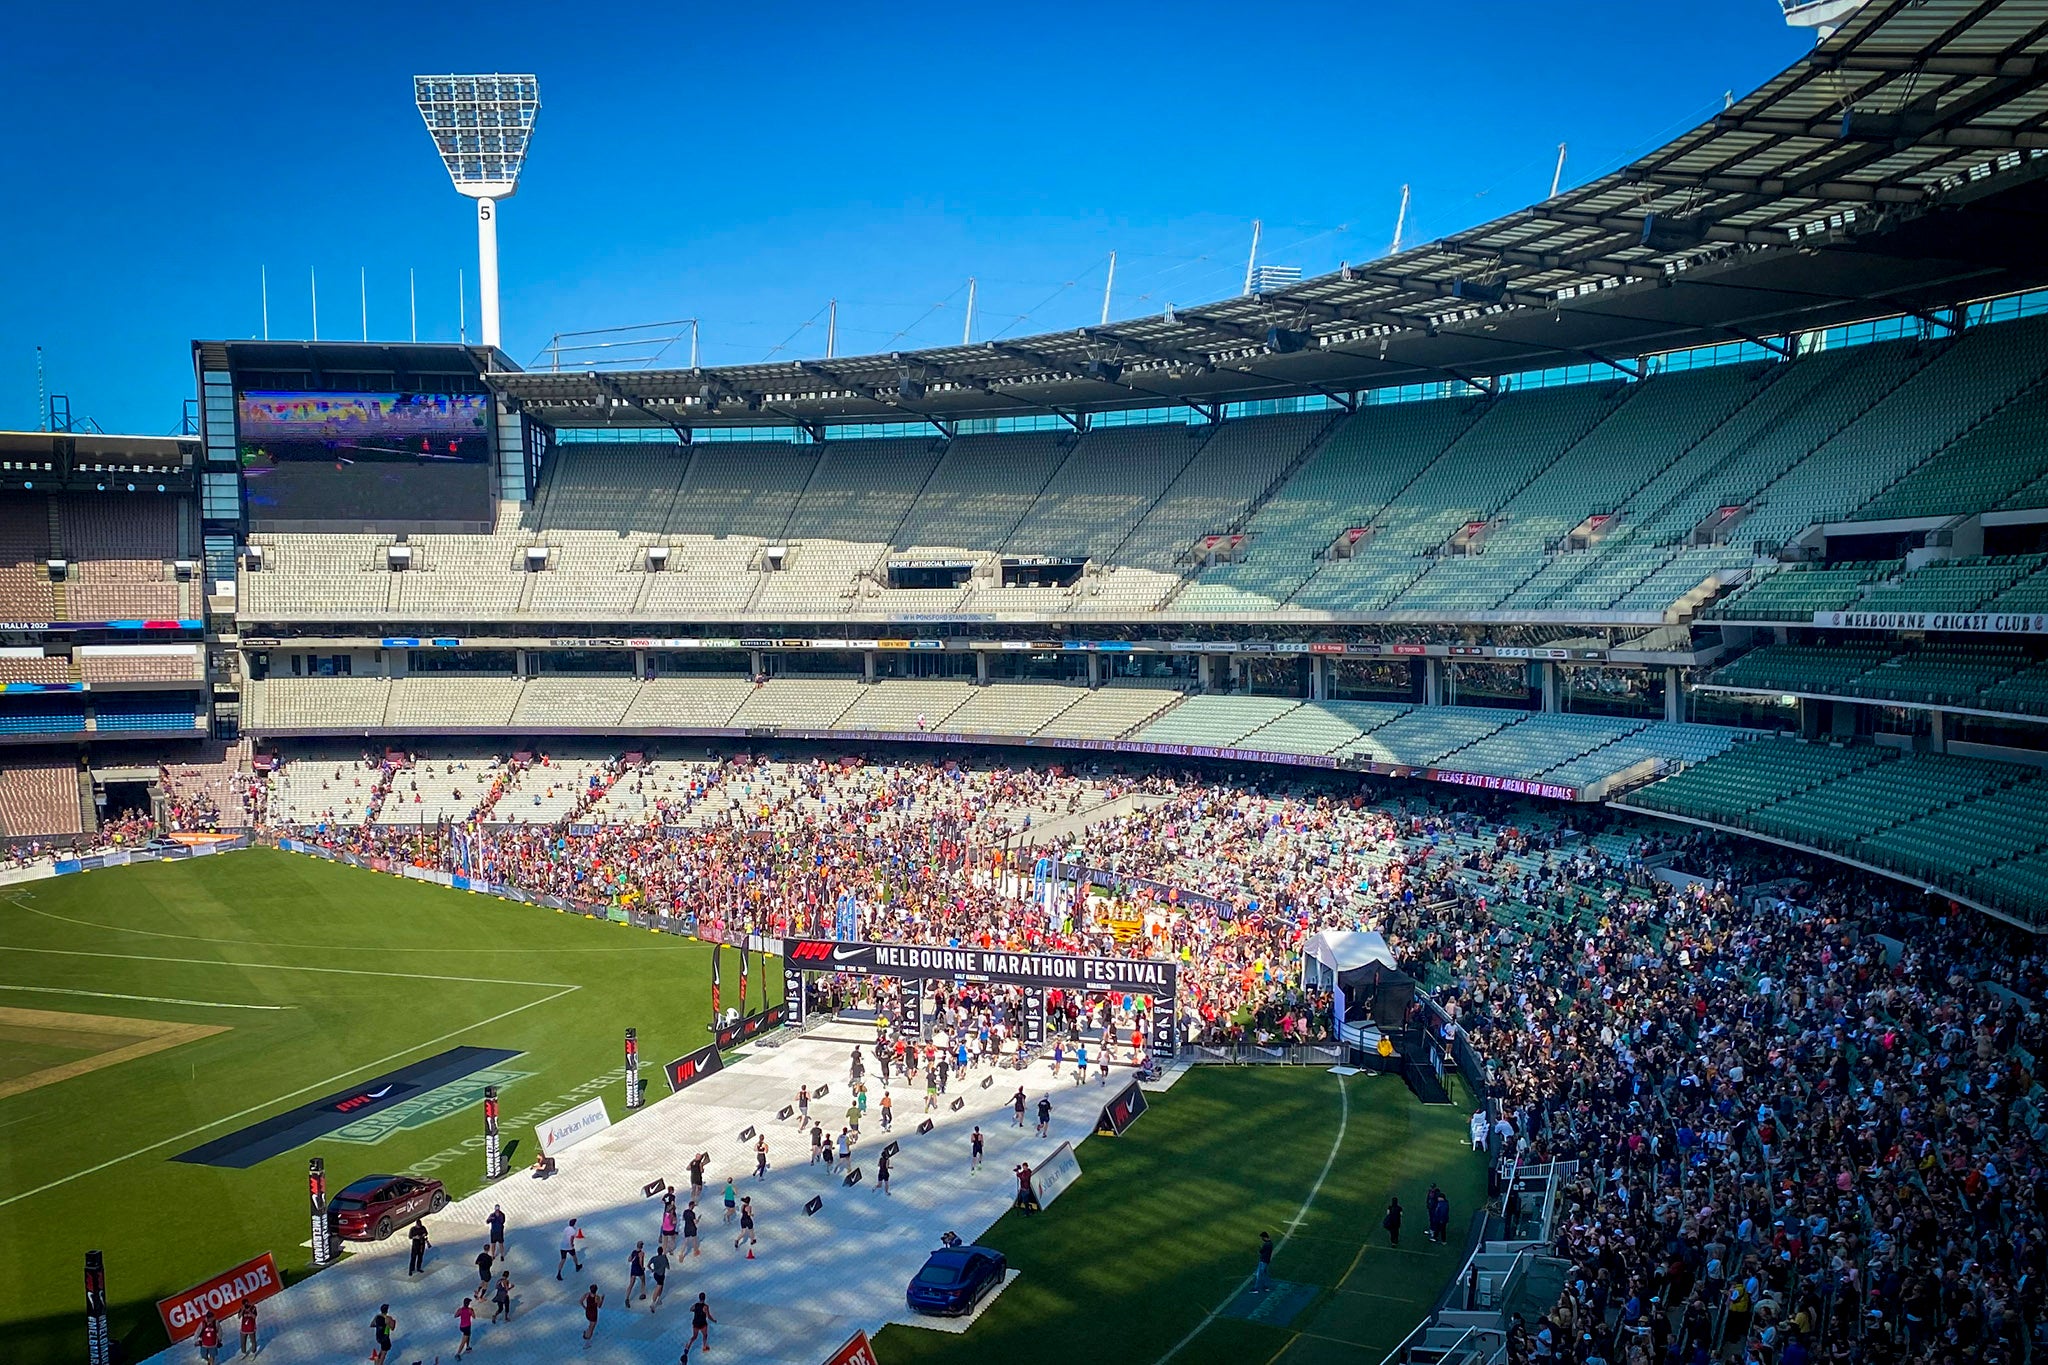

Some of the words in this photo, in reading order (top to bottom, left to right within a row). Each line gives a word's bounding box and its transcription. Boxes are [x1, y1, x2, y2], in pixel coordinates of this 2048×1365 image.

[480, 206, 490, 220] 5
[30, 622, 48, 630] 2022
[1844, 613, 1925, 629] MELBOURNE
[1933, 615, 1989, 630] CRICKET
[1995, 616, 2031, 631] CLUB
[862, 732, 879, 740] AND
[880, 732, 906, 740] WARM
[907, 733, 944, 742] CLOTHING
[1053, 737, 1079, 748] PLEASE
[1082, 739, 1099, 749] EXIT
[1102, 740, 1116, 750] THE
[1116, 741, 1140, 752] ARENA
[1142, 743, 1156, 753] FOR
[1192, 747, 1218, 758] DRINKS
[1220, 747, 1236, 759] AND
[1237, 749, 1259, 761] WARM
[1261, 751, 1297, 765] CLOTHING
[1437, 771, 1464, 785] PLEASE
[1466, 774, 1483, 787] EXIT
[1484, 776, 1500, 789] THE
[1501, 779, 1525, 793] ARENA
[1526, 782, 1541, 796] FOR
[876, 946, 976, 972] MELBOURNE
[983, 953, 1077, 979] MARATHON
[1083, 961, 1167, 985] FESTIVAL
[421, 1096, 475, 1115] 2022
[553, 1121, 581, 1141] SriLankan
[582, 1110, 604, 1128] Airlines
[169, 1264, 272, 1328] GATORADE
[88, 1315, 99, 1365] #MELBMAR
